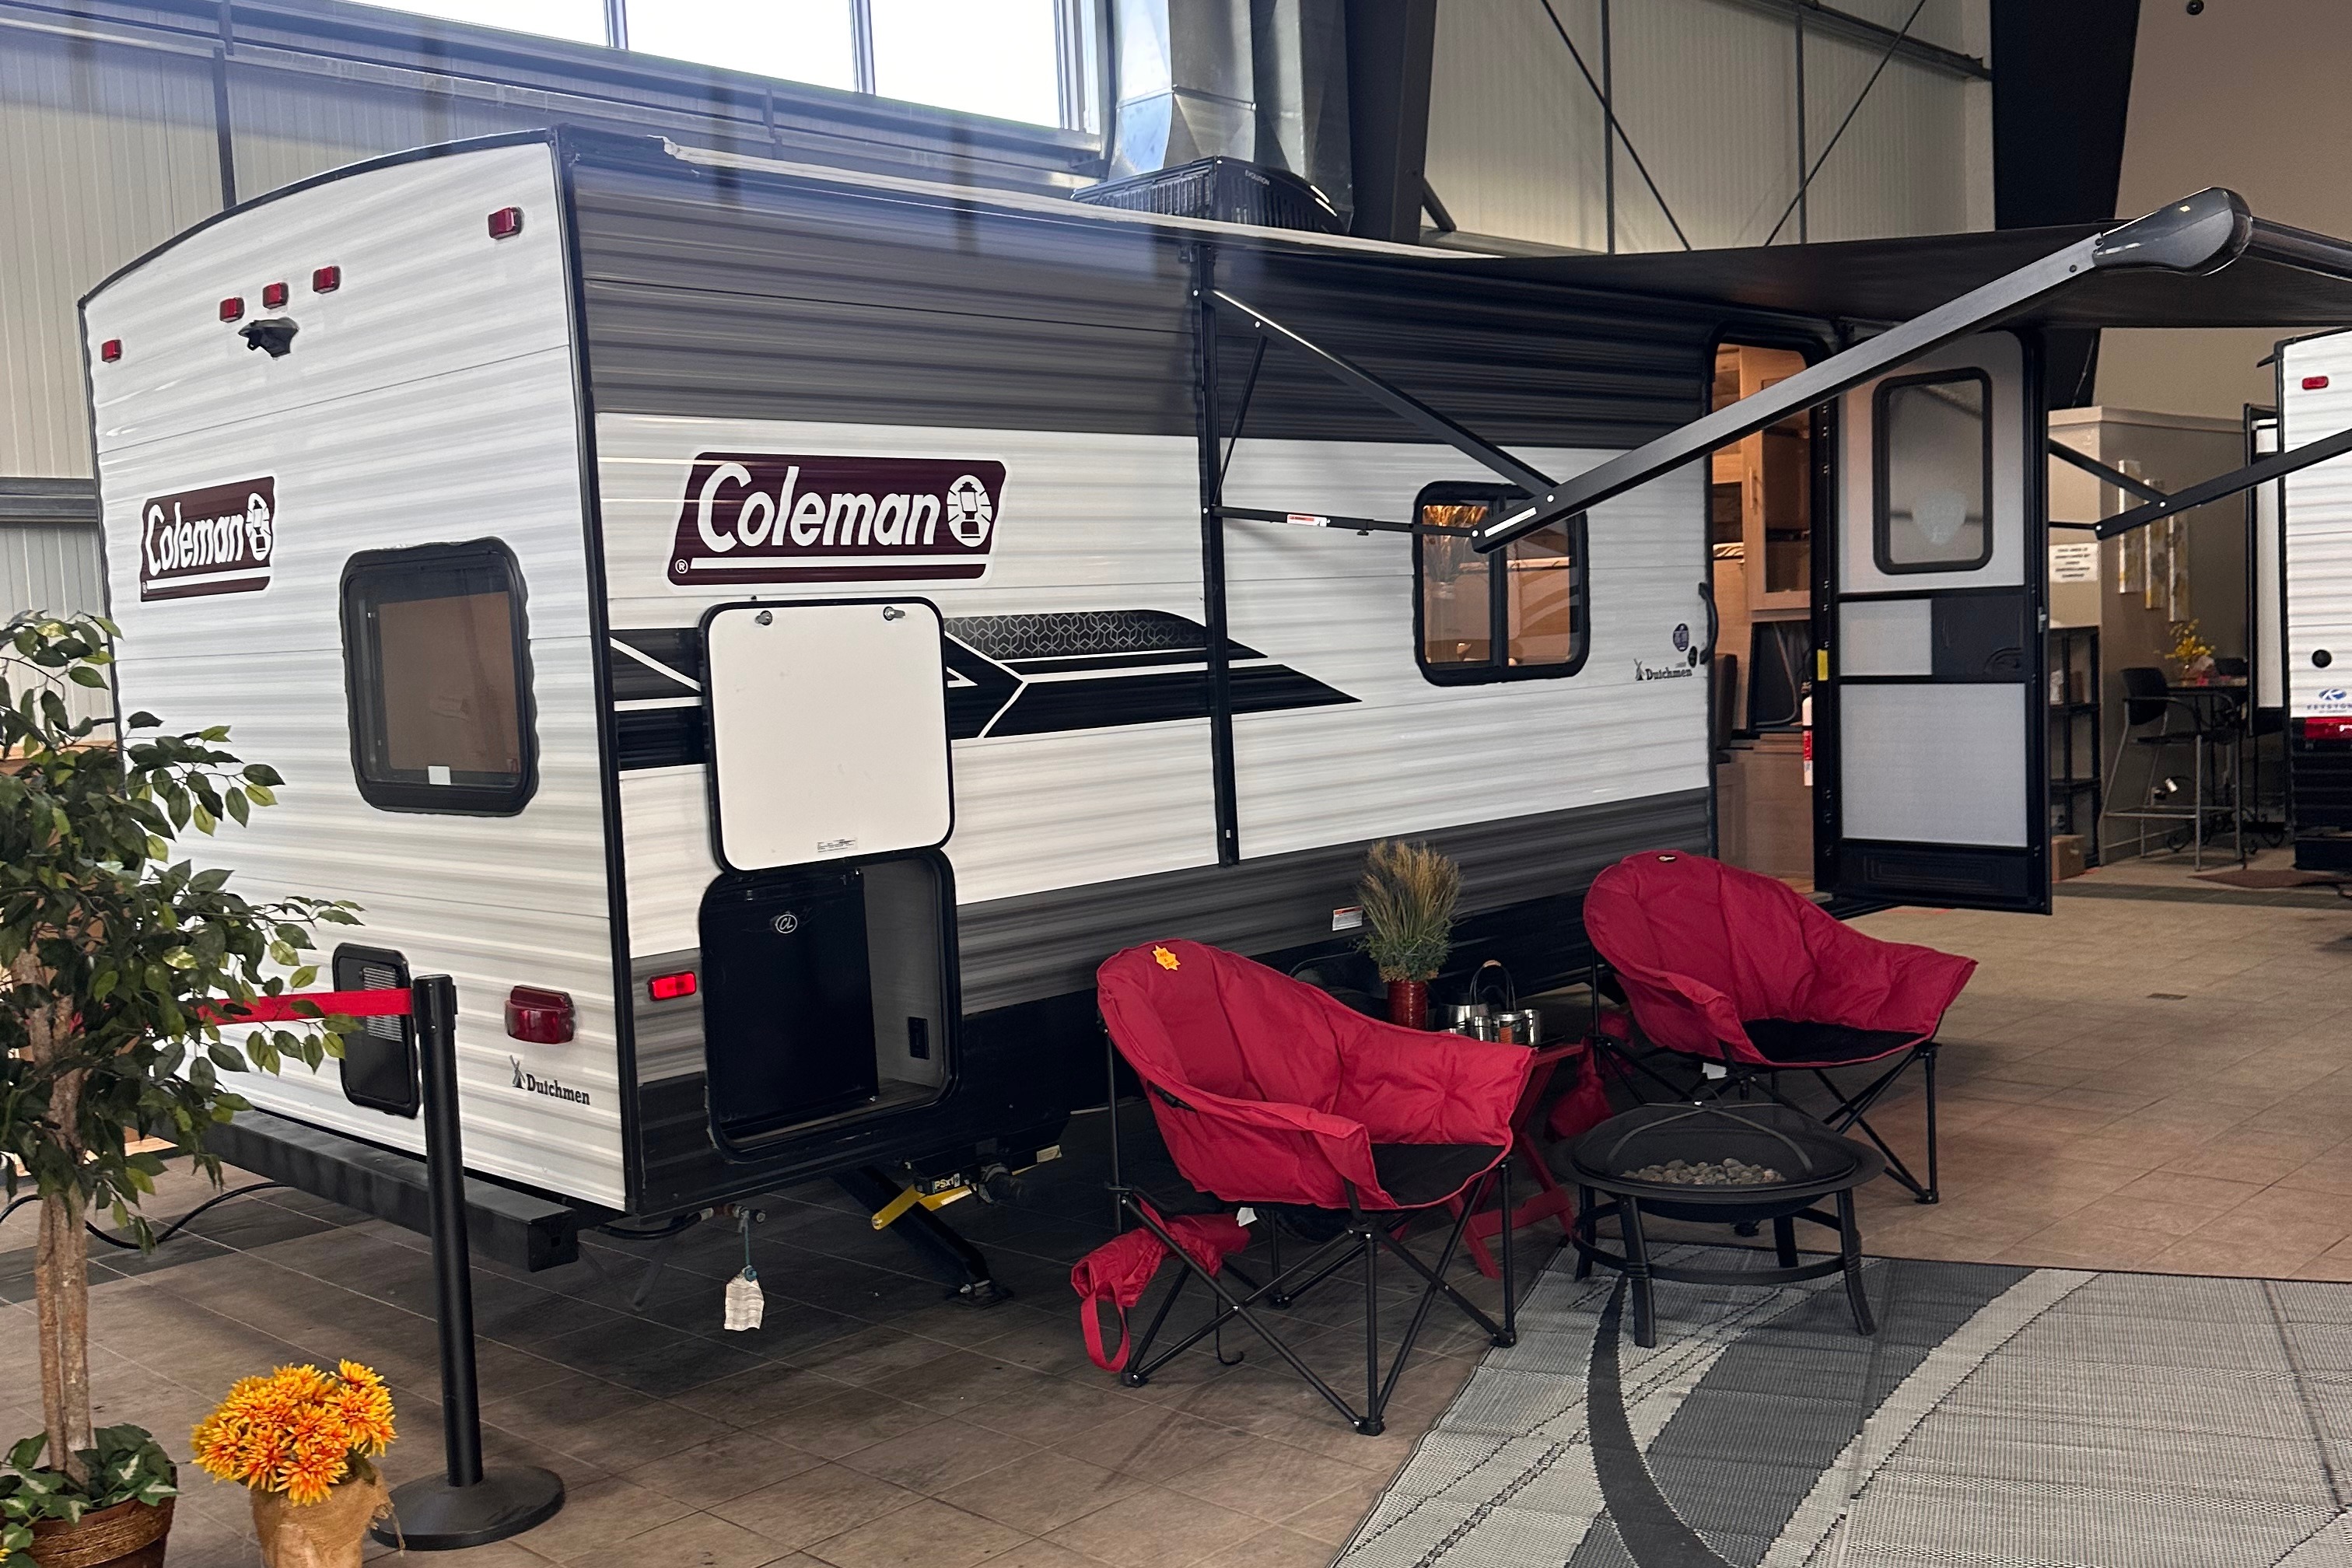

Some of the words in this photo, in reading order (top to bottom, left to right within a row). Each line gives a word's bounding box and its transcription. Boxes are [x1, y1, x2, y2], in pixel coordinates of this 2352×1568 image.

[145, 502, 244, 576] Coleman
[697, 462, 941, 553] Coleman
[526, 1073, 590, 1105] Dutchmen
